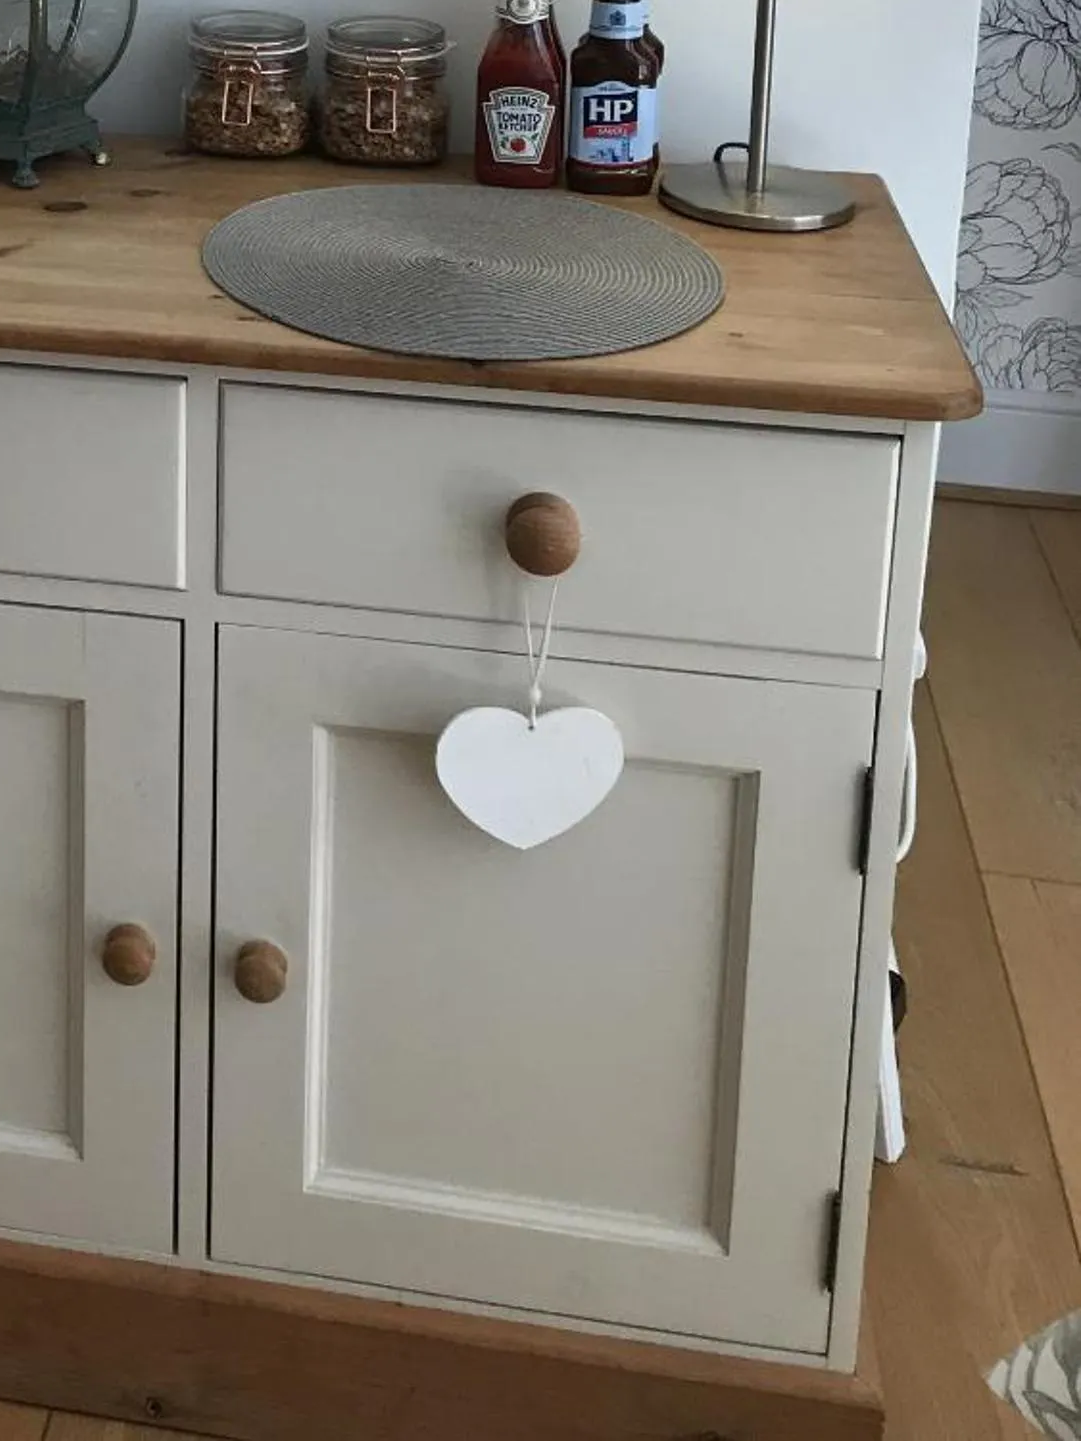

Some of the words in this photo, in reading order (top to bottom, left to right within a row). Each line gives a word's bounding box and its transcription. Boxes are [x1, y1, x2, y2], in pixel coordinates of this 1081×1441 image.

[500, 95, 538, 109] HEINZ
[496, 111, 542, 122] TOMATO
[588, 98, 634, 122] HP
